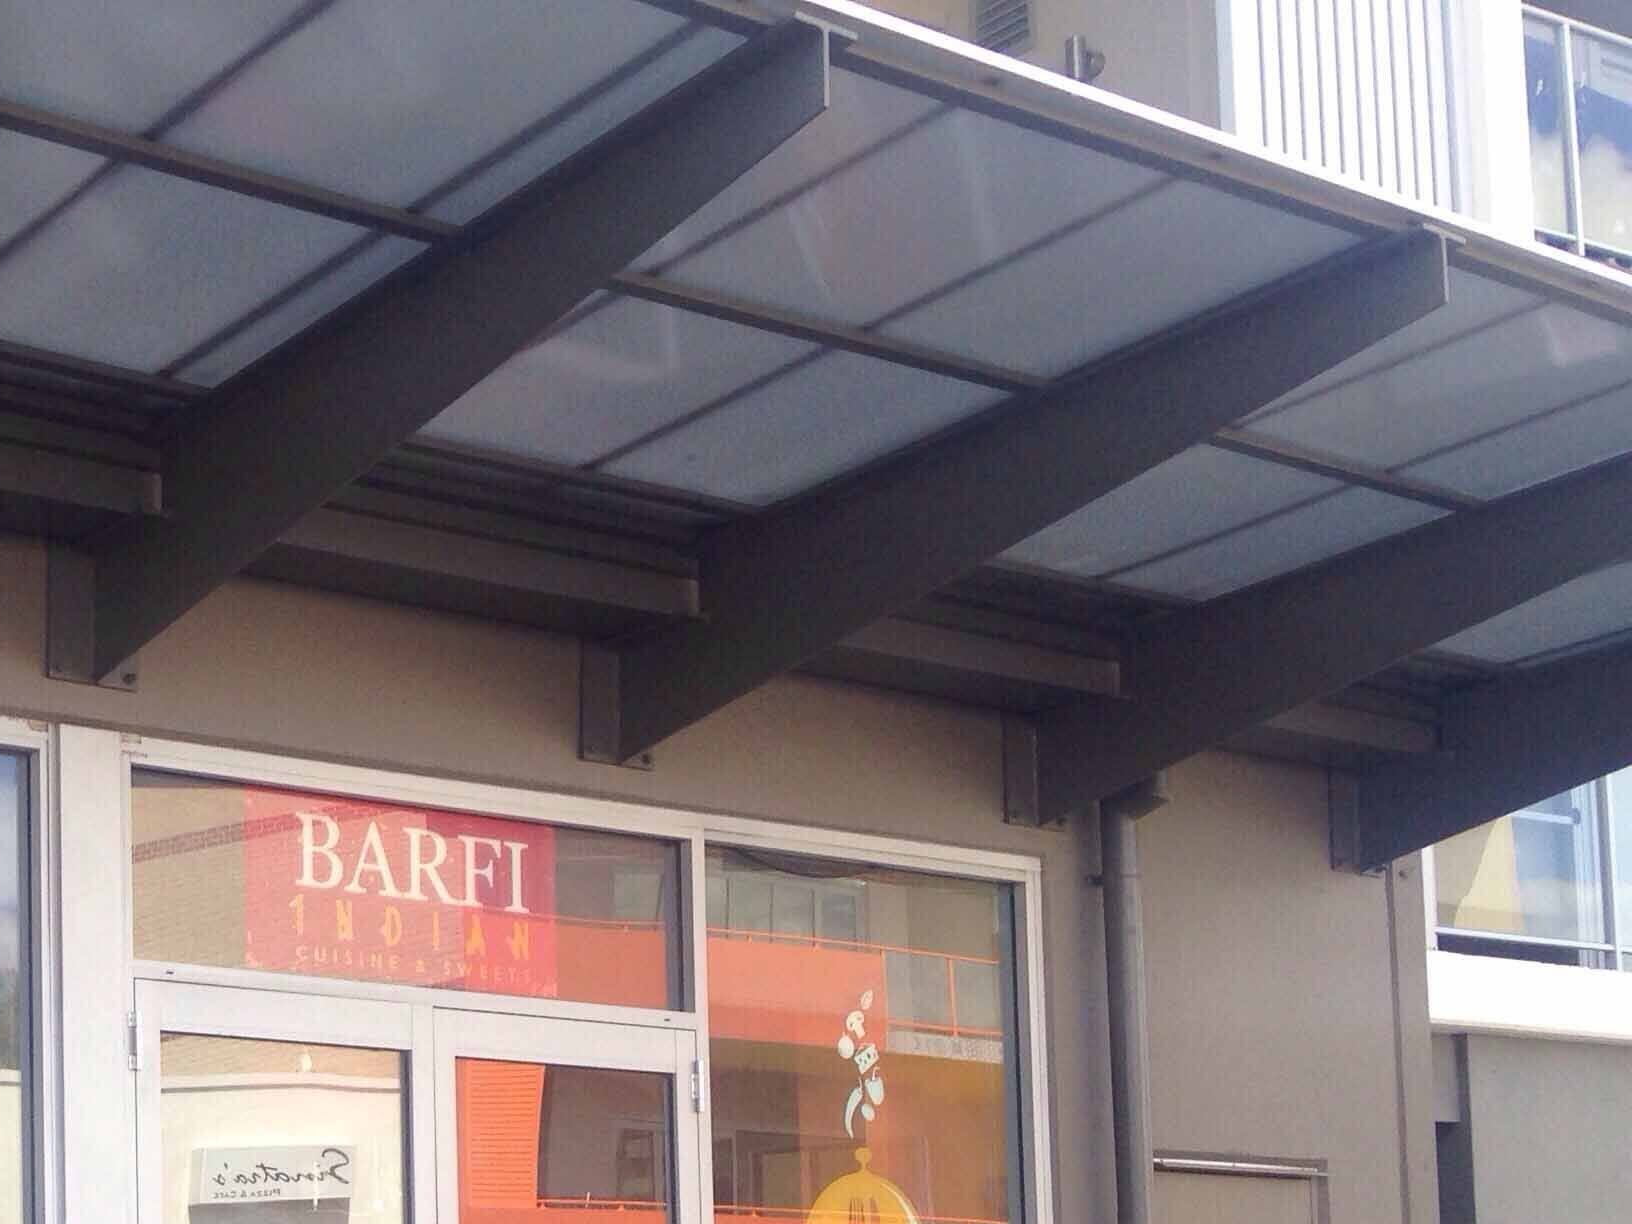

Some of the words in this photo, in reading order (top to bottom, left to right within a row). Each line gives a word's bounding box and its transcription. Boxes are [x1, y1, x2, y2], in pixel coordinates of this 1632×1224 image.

[295, 811, 530, 914] BARFI
[288, 893, 530, 961] INDIAN
[294, 945, 401, 970] CUISINE
